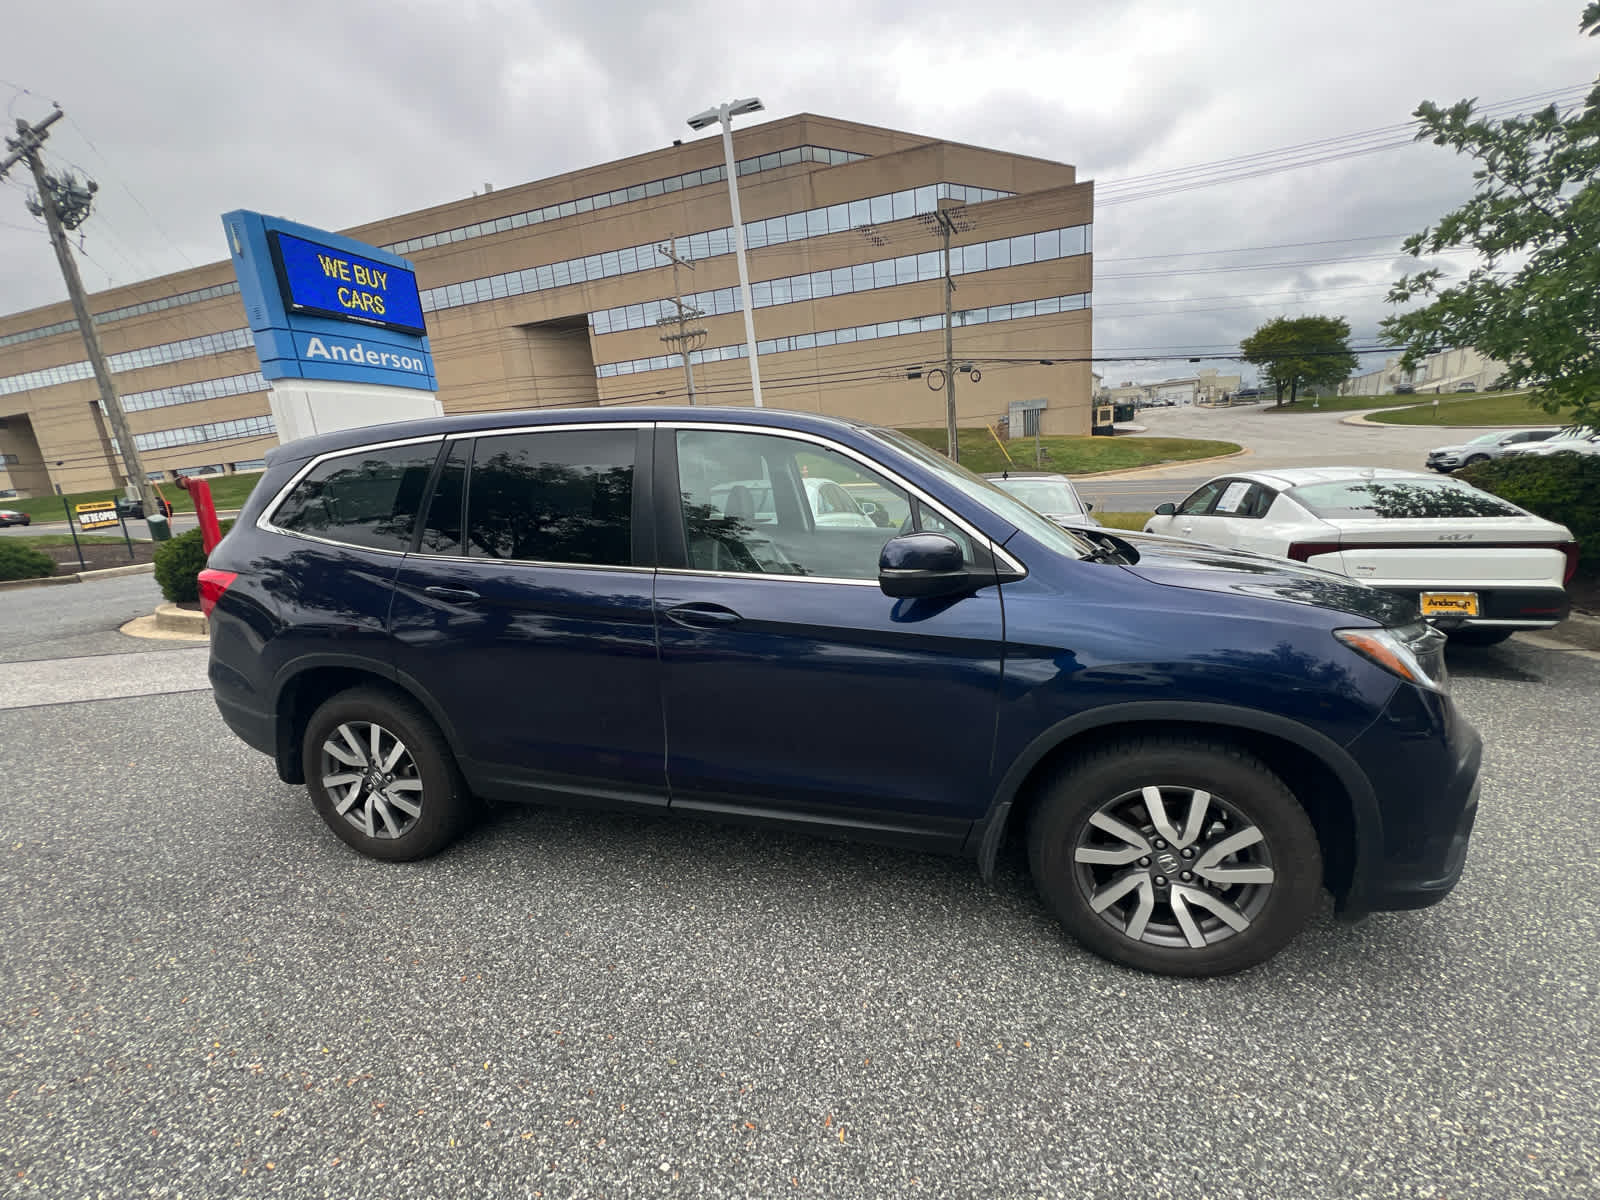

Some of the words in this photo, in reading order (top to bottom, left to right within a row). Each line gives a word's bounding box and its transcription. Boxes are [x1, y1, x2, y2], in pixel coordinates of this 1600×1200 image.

[317, 253, 352, 283] WE
[352, 263, 387, 291] BUY
[337, 286, 386, 315] CARS
[305, 337, 424, 372] Anderson
[98, 510, 118, 521] OPEN
